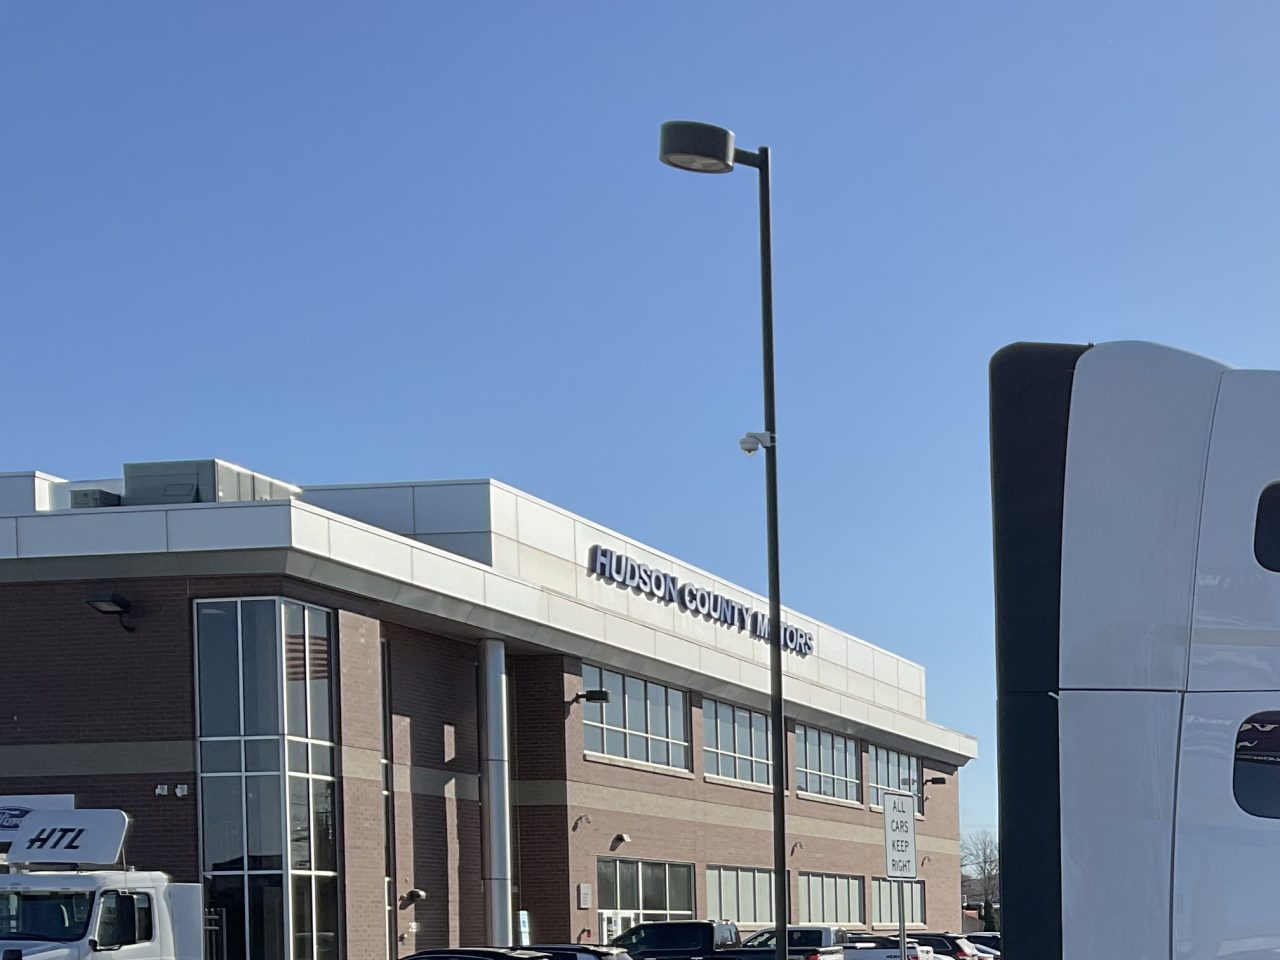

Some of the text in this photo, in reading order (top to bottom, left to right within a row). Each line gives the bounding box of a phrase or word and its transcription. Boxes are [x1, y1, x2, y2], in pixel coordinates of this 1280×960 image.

[587, 544, 815, 657] HUDSON COUNTY MTORS
[892, 800, 906, 813] ALL
[890, 819, 909, 833] CARS
[25, 827, 86, 850] HTL
[891, 839, 910, 853] KEEP
[891, 859, 911, 873] RIGHT
